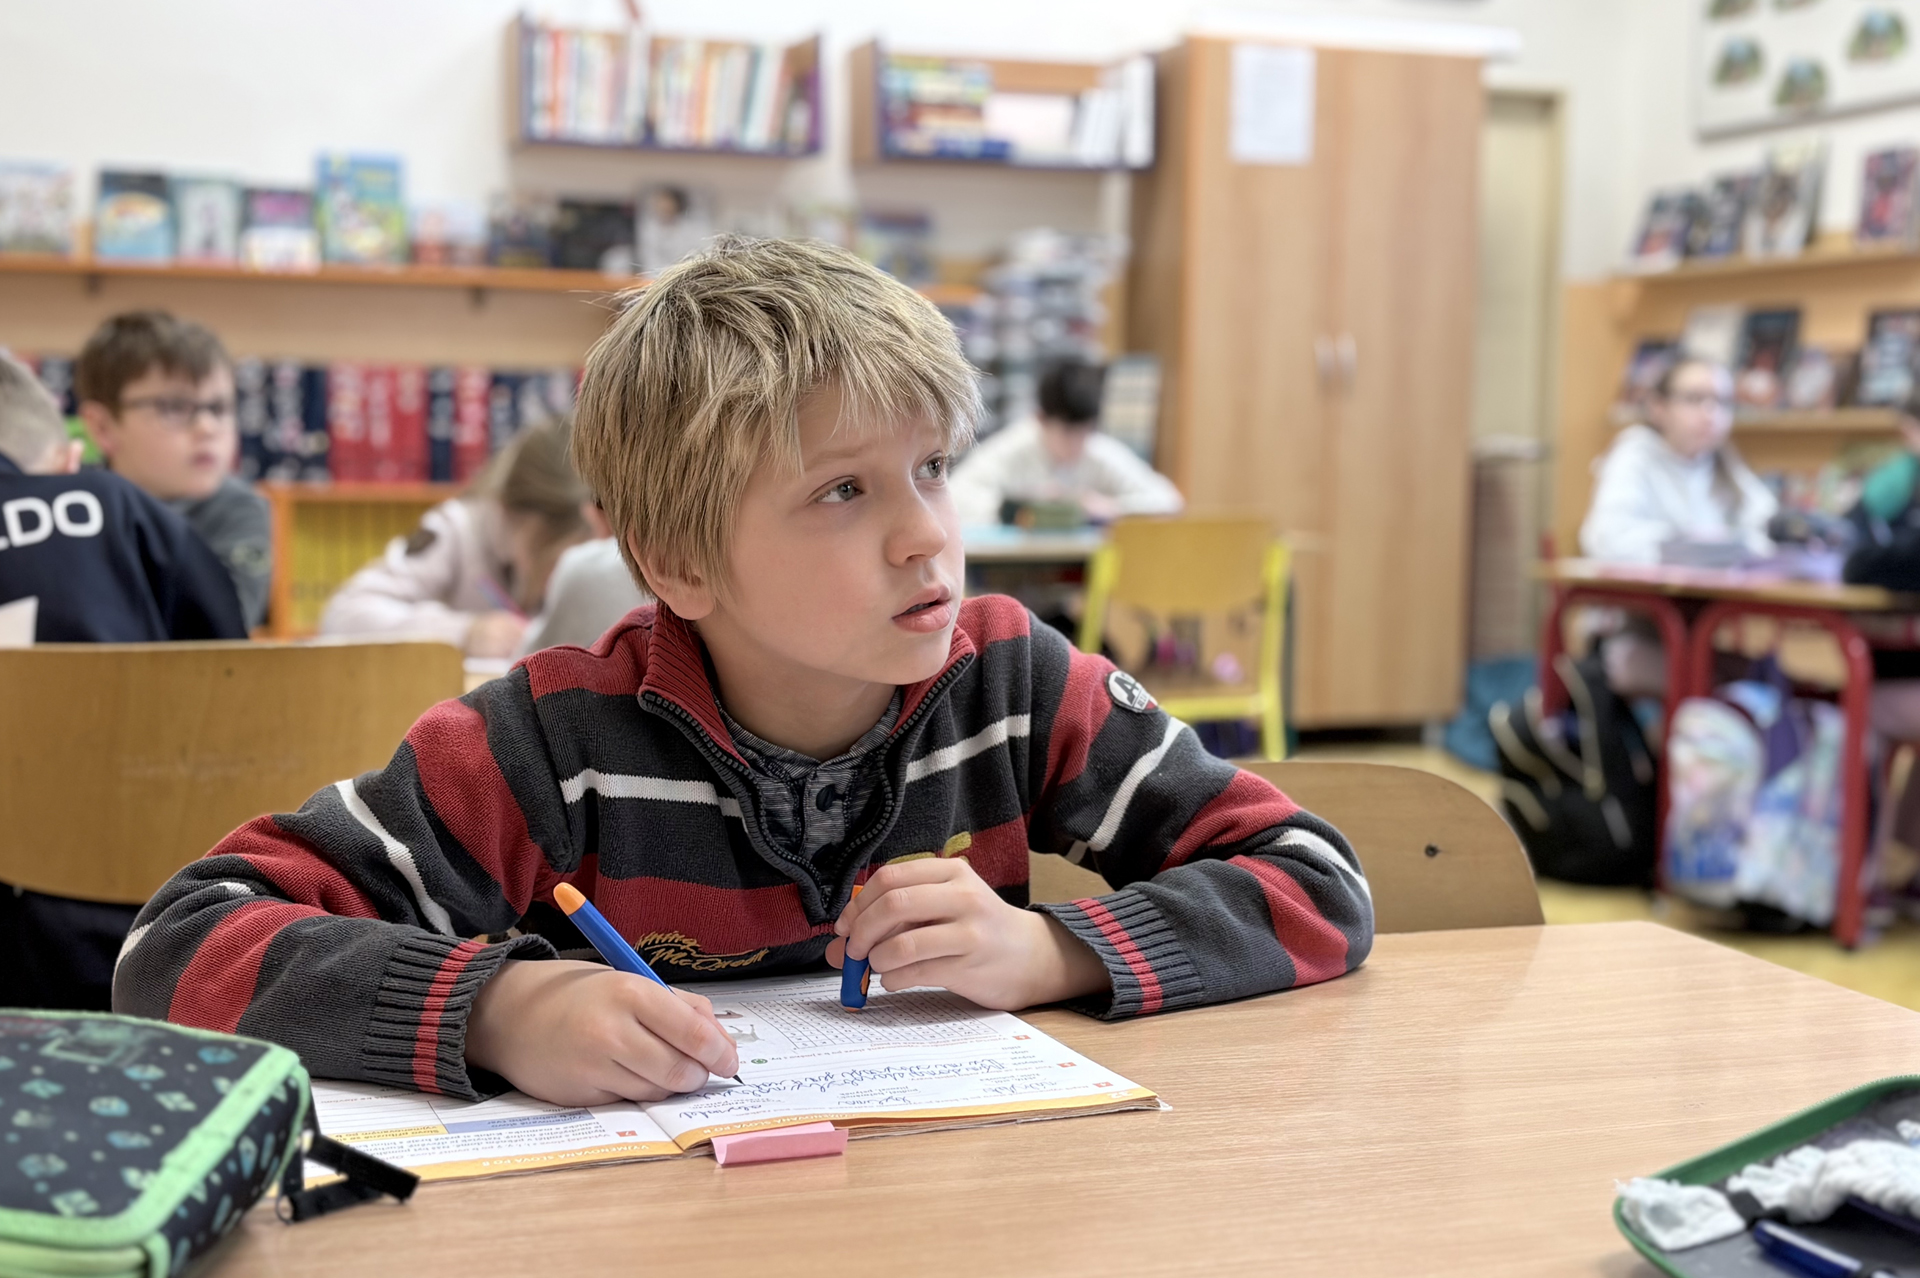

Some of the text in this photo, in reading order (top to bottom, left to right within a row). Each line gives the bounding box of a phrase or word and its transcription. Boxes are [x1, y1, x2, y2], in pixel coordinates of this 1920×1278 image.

[0, 489, 104, 550] DO
[1114, 675, 1140, 705] A
[514, 1154, 555, 1163] SLOVA
[557, 1145, 650, 1159] VYJMENOVANÁ
